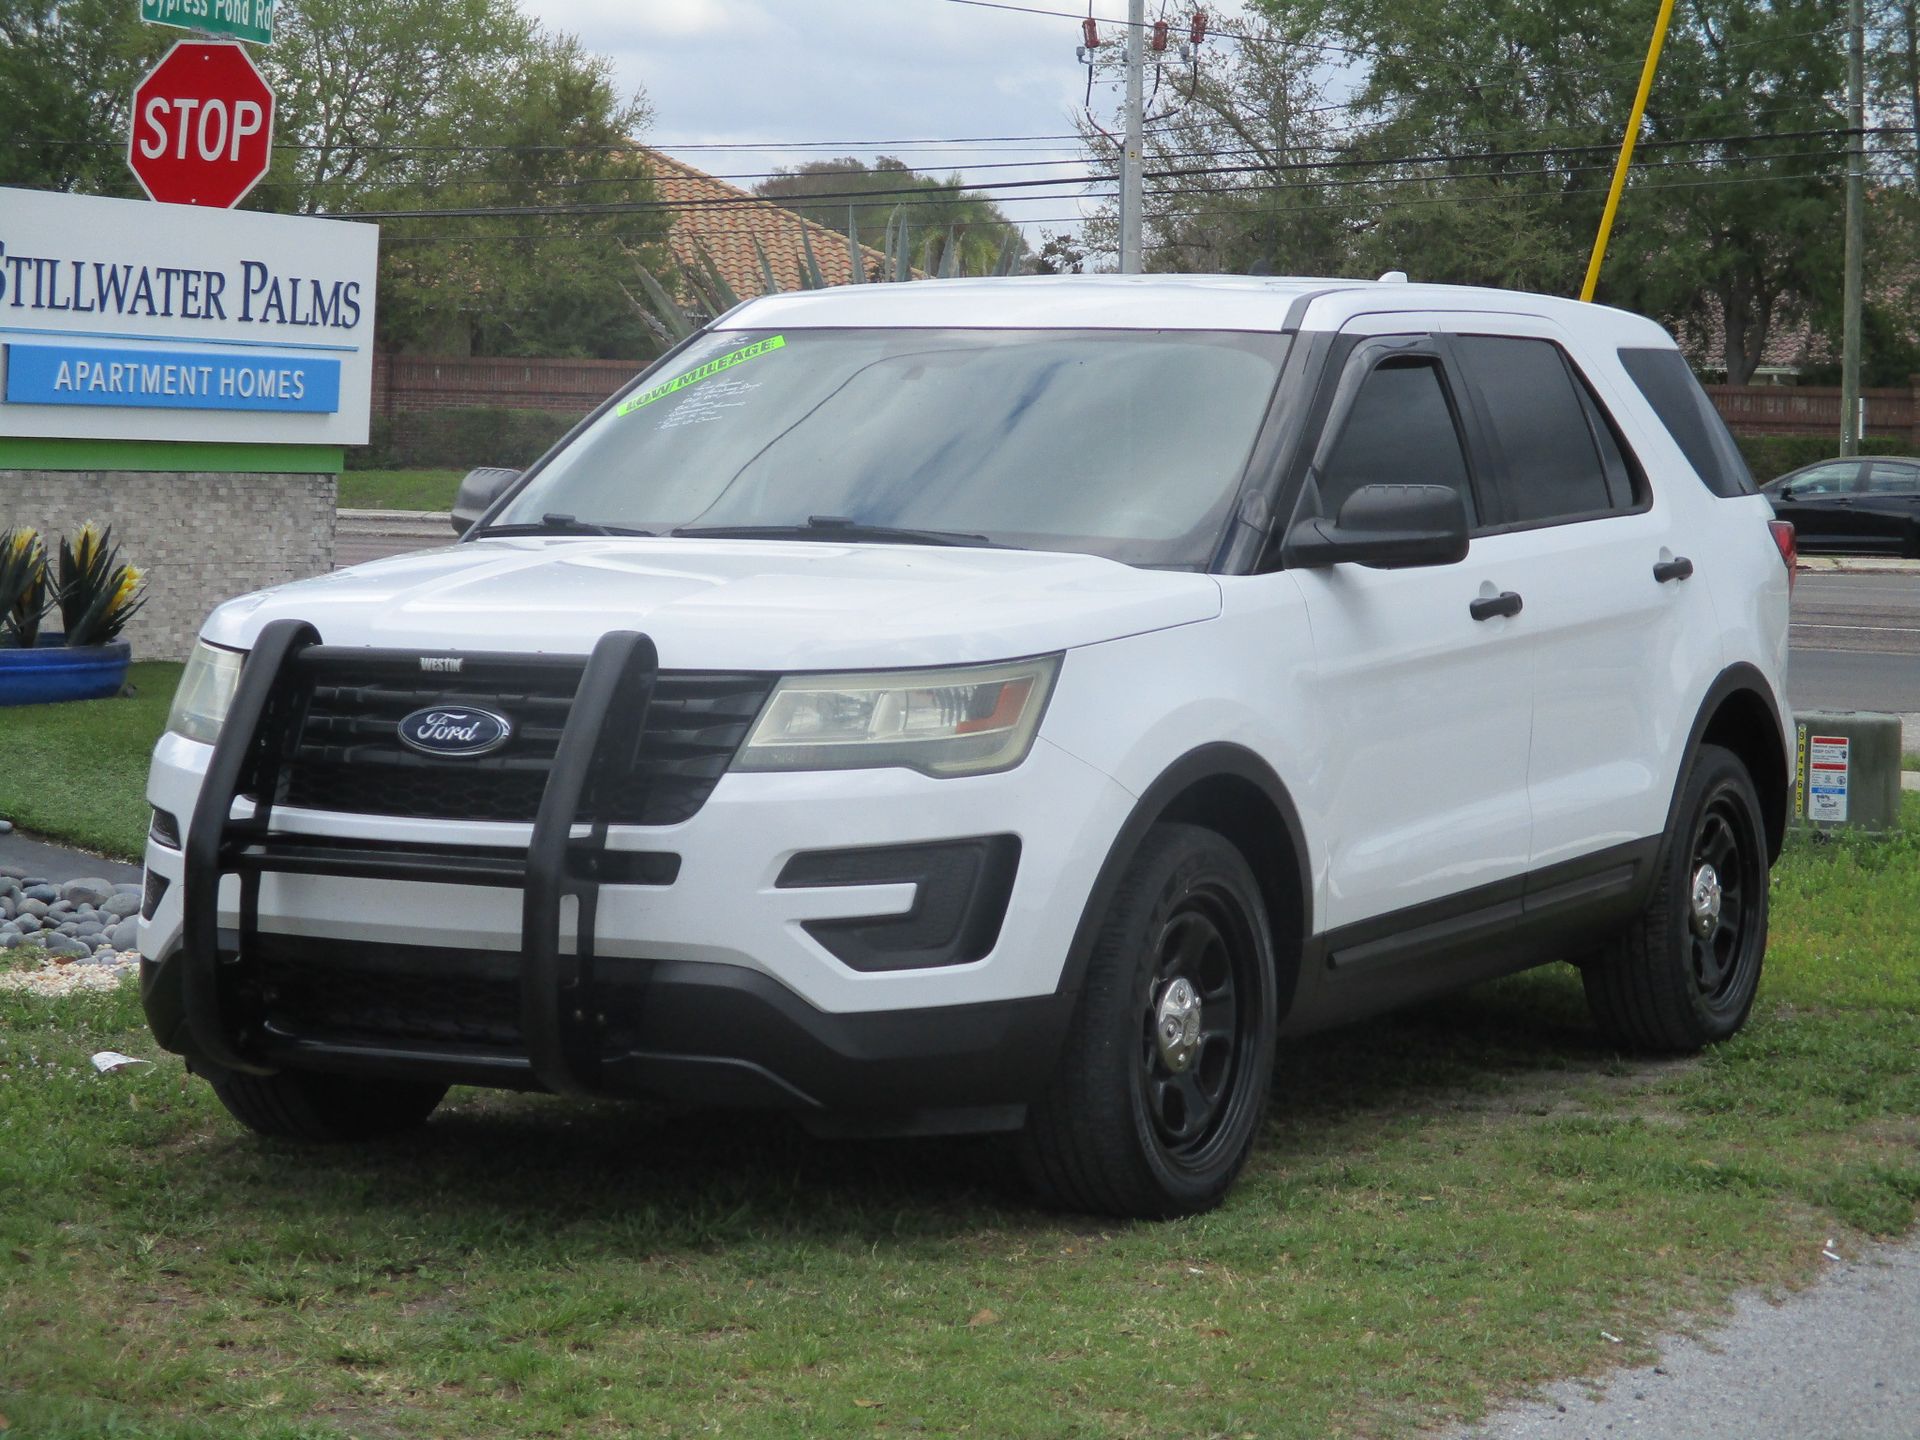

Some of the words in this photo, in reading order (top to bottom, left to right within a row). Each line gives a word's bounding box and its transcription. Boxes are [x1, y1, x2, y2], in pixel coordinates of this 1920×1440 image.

[145, 0, 208, 18] ypress
[214, 0, 250, 26] Pond
[255, 0, 272, 31] Rd
[139, 97, 263, 162] STOP
[239, 260, 361, 329] PALMS
[53, 361, 213, 397] APARTMENT
[219, 367, 305, 400] HOMES
[677, 338, 774, 386] MILEAGE
[420, 657, 464, 672] WESTIN
[416, 712, 481, 741] Ford
